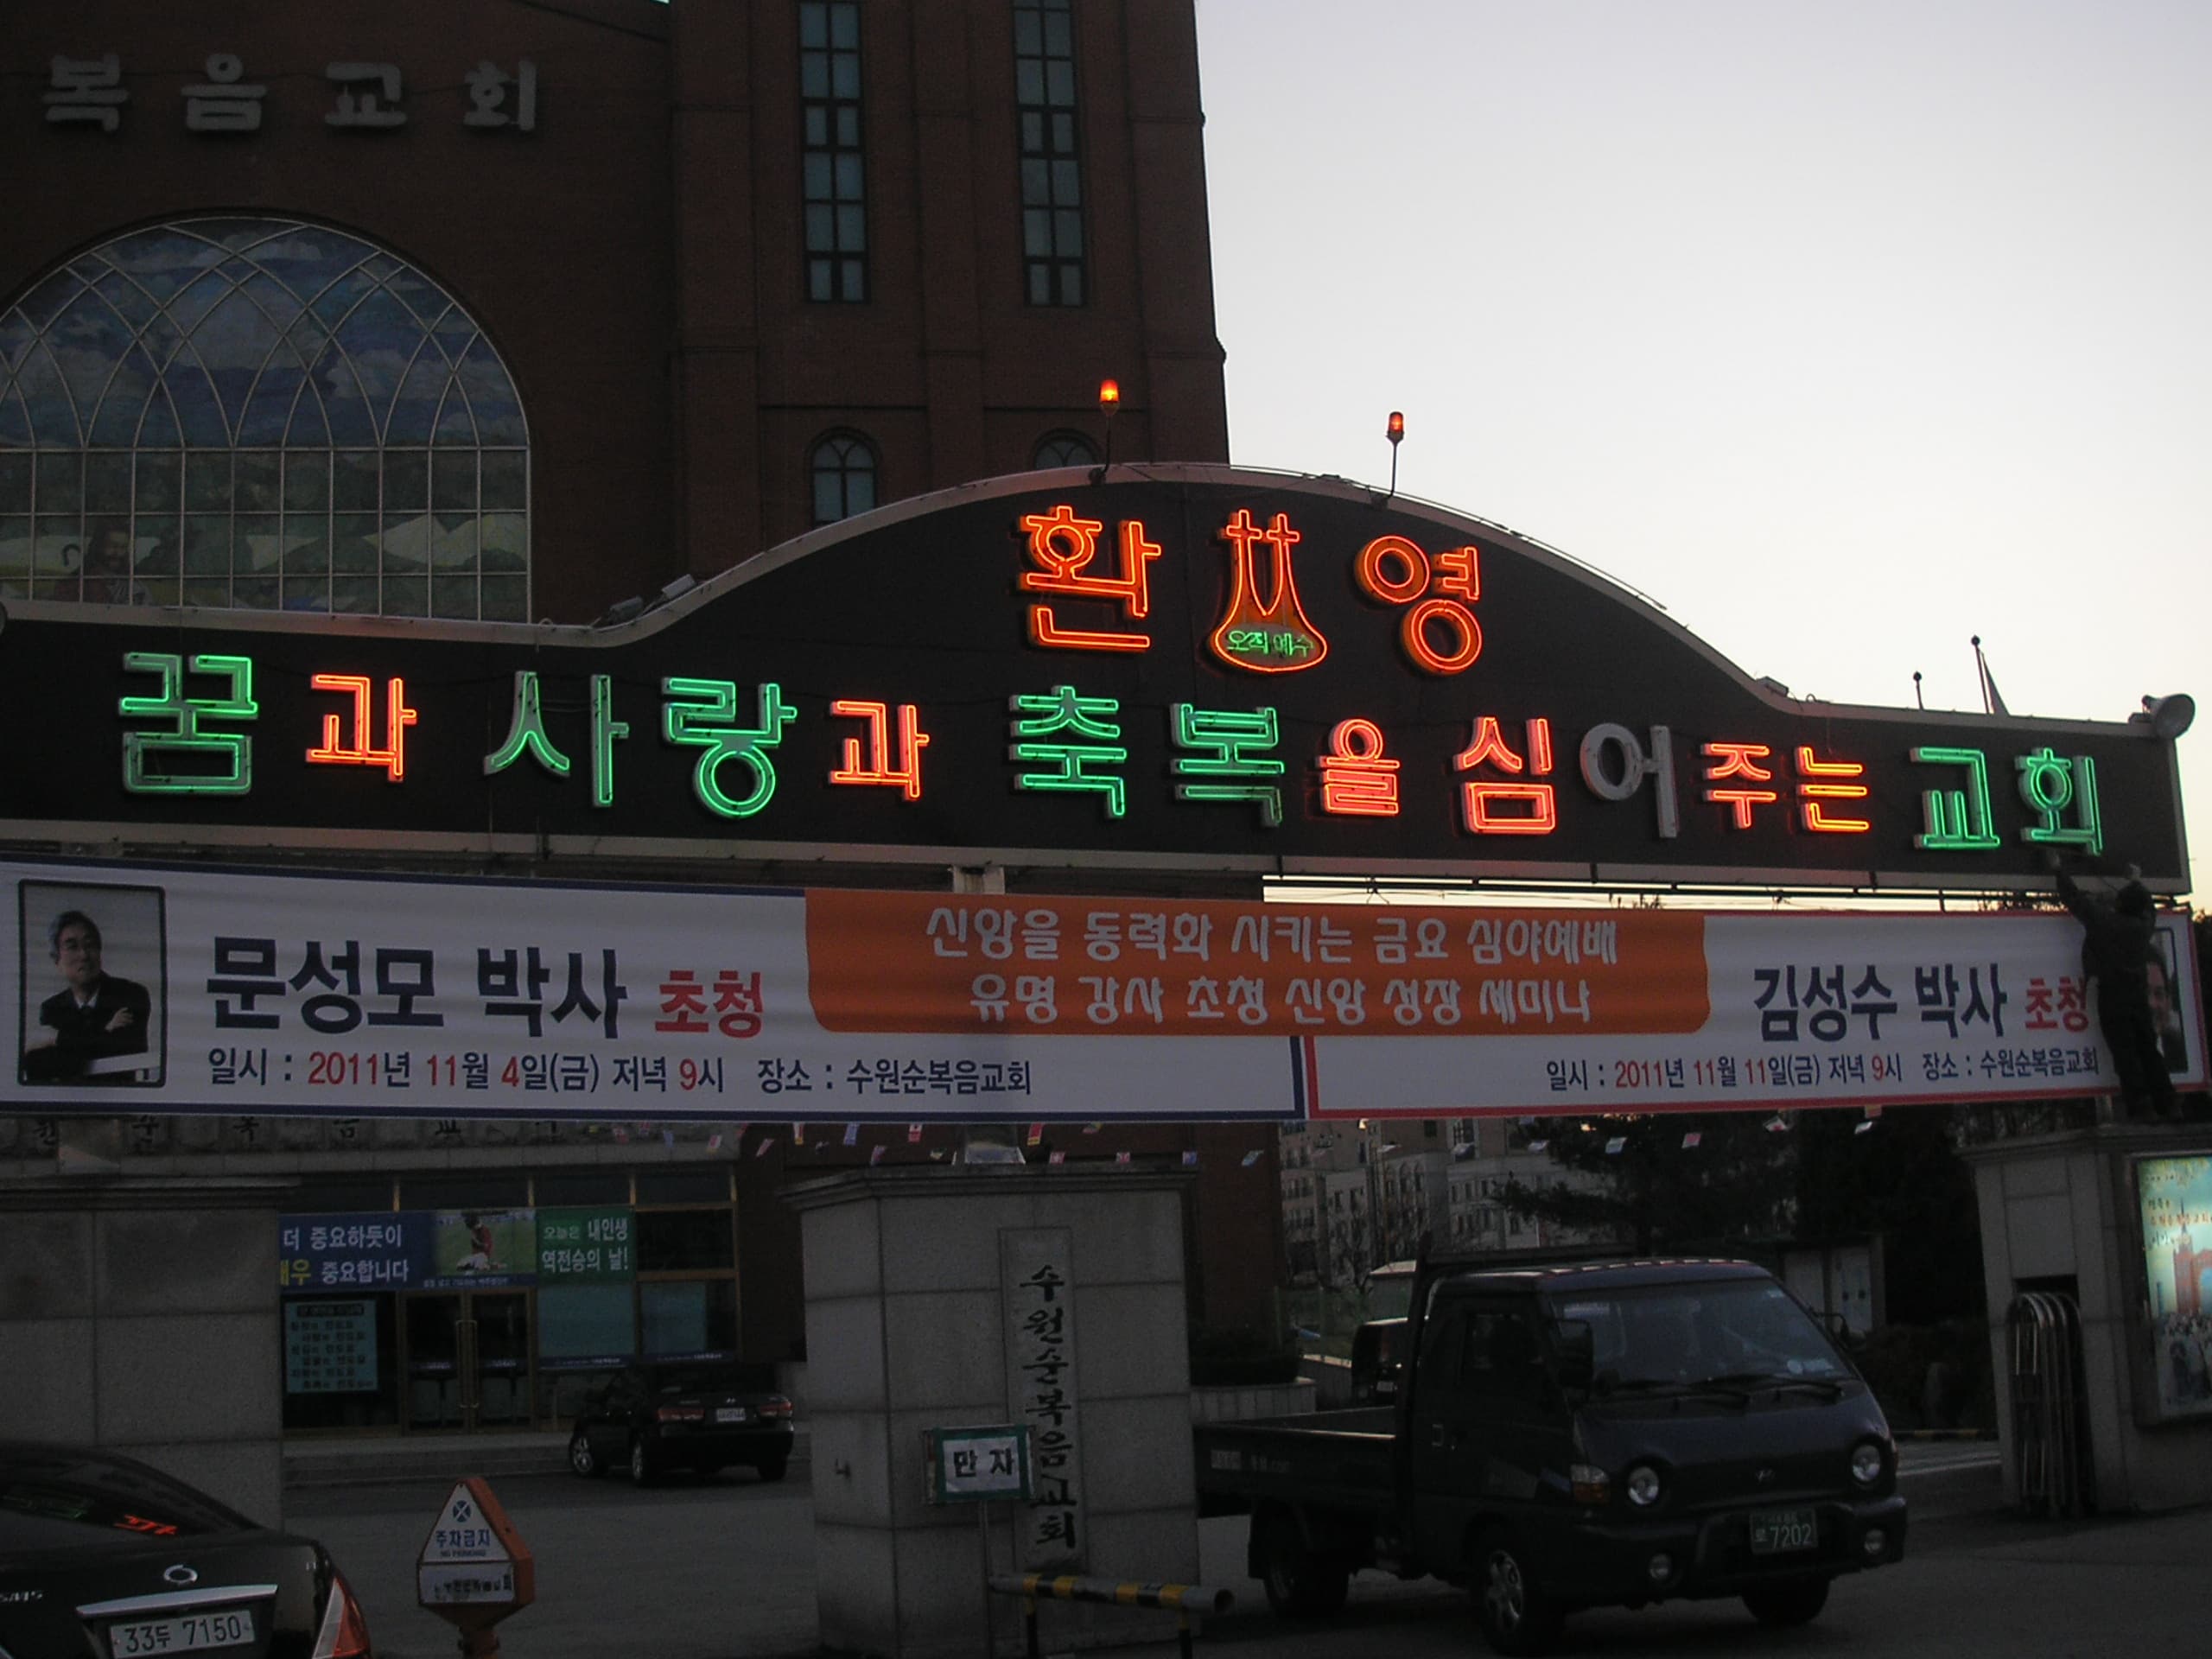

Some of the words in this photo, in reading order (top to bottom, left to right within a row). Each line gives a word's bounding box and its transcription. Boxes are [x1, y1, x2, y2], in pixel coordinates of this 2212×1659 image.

[41, 53, 538, 131] 복음교회
[1227, 630, 1272, 654] 오직
[1273, 632, 1314, 658] 예수
[484, 671, 930, 820] 사랑과
[1008, 685, 1403, 828] 축복을
[1910, 747, 2103, 855] 교회
[926, 907, 1060, 960] 신앙을
[1084, 912, 1212, 961] 동력화
[1231, 914, 1352, 963] 시키는
[1373, 917, 1448, 963] 금요
[1468, 918, 1618, 965] 심야예배
[207, 937, 443, 1034] 문성모
[477, 947, 627, 1039] 박사
[654, 969, 764, 1039] 초청
[970, 974, 1058, 1024] 유명
[1079, 976, 1164, 1024] 강사
[1187, 975, 1264, 1026] 초청
[1286, 977, 1366, 1026] 신앙
[1383, 978, 1460, 1026] 성장
[1479, 979, 1590, 1023] 세미나
[1753, 964, 1897, 1041] 김성수
[1915, 963, 2007, 1038] 박사
[2025, 977, 2089, 1033] 초청
[208, 1047, 267, 1086] 일시
[308, 1051, 410, 1089] 2011년
[426, 1052, 489, 1090] 11월
[500, 1052, 599, 1093] 4일(금)
[613, 1054, 667, 1092] 저녁
[680, 1057, 724, 1093] 9시
[758, 1058, 812, 1094] 장소
[847, 1059, 1032, 1096] 수원순복음교회
[1547, 1060, 1588, 1090] 일시
[1615, 1058, 1684, 1090] 2011년
[1694, 1056, 1736, 1088] 11월
[1745, 1053, 1820, 1088] 11일(금)
[1829, 1052, 1865, 1084] 저녁
[1872, 1053, 1902, 1082] 9시
[1923, 1051, 1959, 1079] 장소
[1980, 1046, 2099, 1078] 수원순복음교회
[283, 1226, 300, 1250] 더
[309, 1224, 402, 1250] 중요하듯이
[321, 1259, 410, 1285] 중요합니다
[542, 1247, 601, 1274] 역전승의
[1020, 1265, 1077, 1548] 수원순복음교회
[435, 1529, 490, 1548] 주차금지
[182, 1616, 241, 1645] 7150
